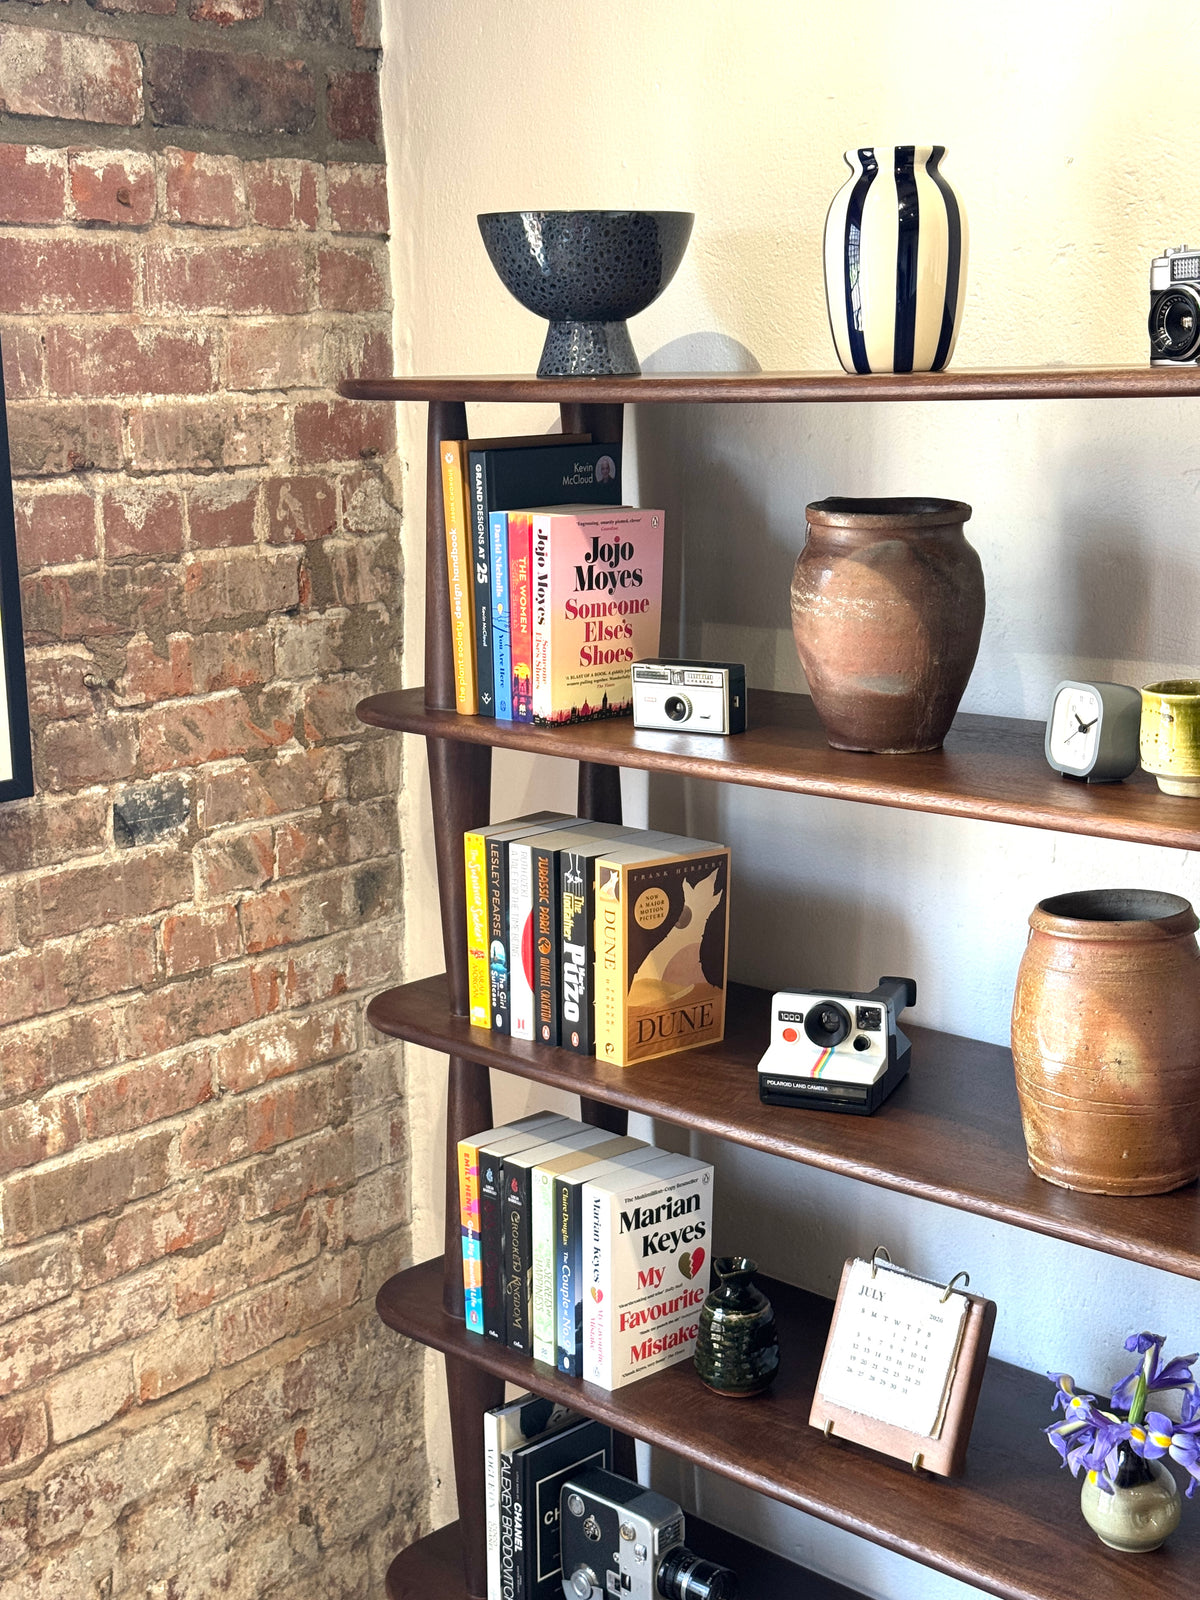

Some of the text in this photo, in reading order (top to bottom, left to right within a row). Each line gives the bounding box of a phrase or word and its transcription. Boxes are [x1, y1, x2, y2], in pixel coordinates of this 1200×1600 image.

[475, 464, 483, 501] GRAND
[562, 473, 593, 486] McCloud
[573, 462, 593, 473] Kevin
[476, 503, 485, 545] DESIGNS
[494, 524, 502, 554] David
[449, 528, 460, 581] handbook
[478, 546, 485, 560] AT
[584, 535, 635, 568] Jojo
[476, 562, 488, 584] 25
[495, 555, 504, 598] Nicholls
[535, 528, 548, 625] Jojo Moyes
[573, 564, 643, 595] Moyes
[453, 583, 463, 619] design
[519, 556, 528, 633] THE WOMEN
[564, 597, 650, 620] Someone
[456, 621, 465, 657] society
[583, 618, 633, 643] Else's
[457, 660, 467, 685] plant
[579, 644, 634, 667] Shoes
[458, 686, 466, 702] the
[468, 860, 482, 906] Summer
[633, 861, 722, 881] FRANK HERBERT
[490, 843, 501, 937] LESLEY PEARSE
[574, 895, 584, 914] The
[563, 891, 575, 941] Godfather
[639, 912, 664, 921] PICTURE
[640, 906, 664, 915] MOTION
[538, 856, 552, 1023] JURASSIC PARK MICHAEL CRICHTON
[604, 908, 616, 970] DUNE
[490, 969, 498, 1007] Suitcase
[498, 973, 506, 989] The
[499, 991, 507, 1009] Girl
[780, 1012, 800, 1021] 1000
[635, 1002, 714, 1044] DUNE
[766, 1079, 793, 1088] POLAROID
[806, 1084, 829, 1092] CAMERA
[463, 1152, 471, 1182] EMILY
[676, 1178, 699, 1189] Bestseller
[464, 1184, 473, 1218] HENRY
[618, 1193, 701, 1235] Marian
[510, 1210, 522, 1273] CROOKED
[561, 1213, 569, 1246] Douglas
[591, 1195, 601, 1283] Marian Keyes
[641, 1220, 706, 1258] Keyes
[534, 1258, 544, 1312] HAPPINESS
[543, 1268, 553, 1310] SECRETS
[560, 1264, 571, 1309] Couple
[637, 1265, 666, 1290] My
[858, 1285, 886, 1302] JULY
[506, 1274, 523, 1330] KINGDOM
[618, 1287, 705, 1333] Favourite
[629, 1323, 699, 1365] Mistake
[501, 1459, 512, 1515] ALEXEY
[513, 1502, 523, 1552] CHANEL
